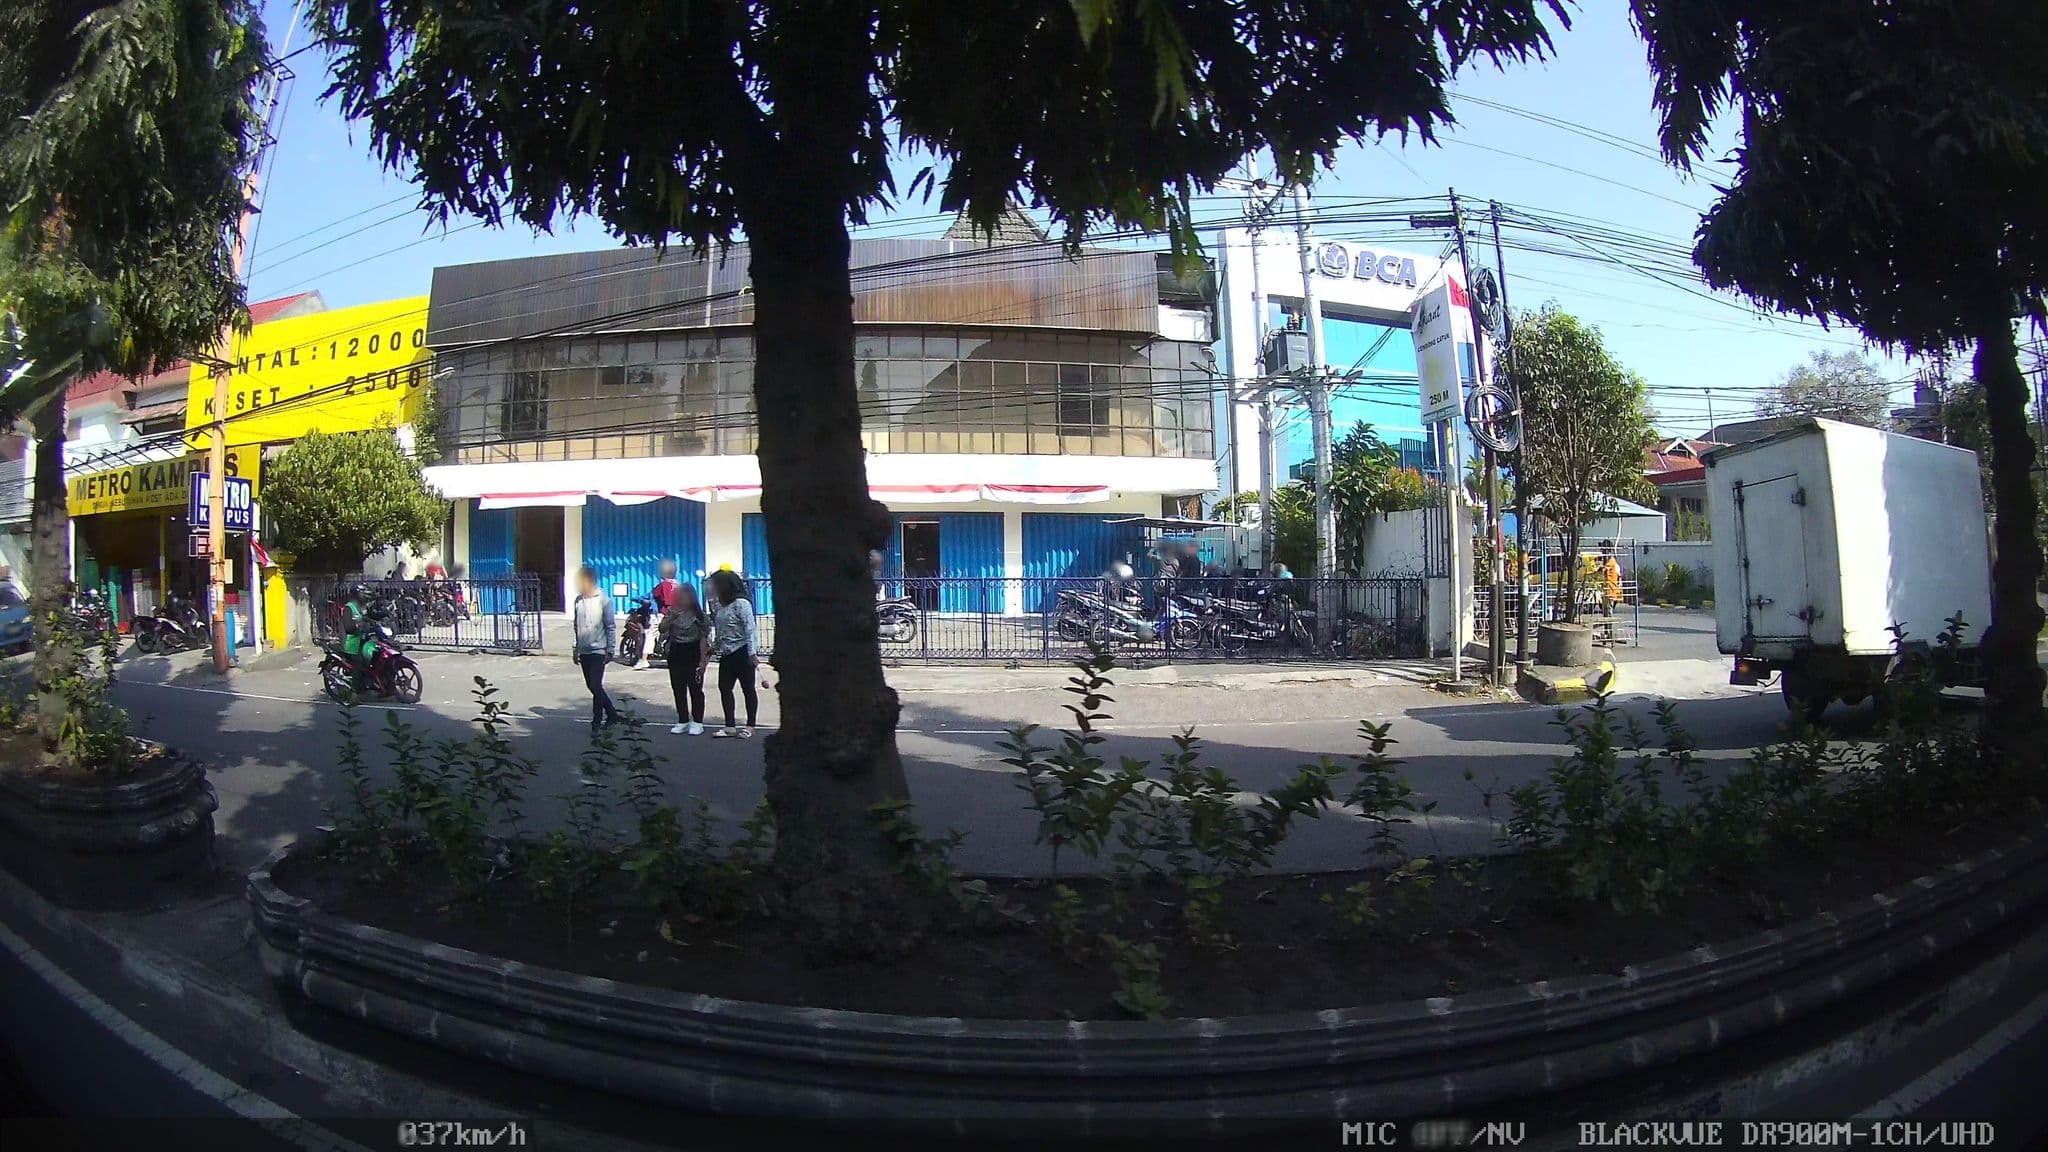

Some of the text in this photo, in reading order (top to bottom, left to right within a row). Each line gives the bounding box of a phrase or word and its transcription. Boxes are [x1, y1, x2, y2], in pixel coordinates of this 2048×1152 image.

[1354, 250, 1417, 288] BCA
[204, 387, 281, 416] KSET
[1429, 391, 1442, 405] 250
[76, 470, 132, 501] METRO
[200, 478, 250, 510] MTRO
[200, 507, 250, 524] KPUS
